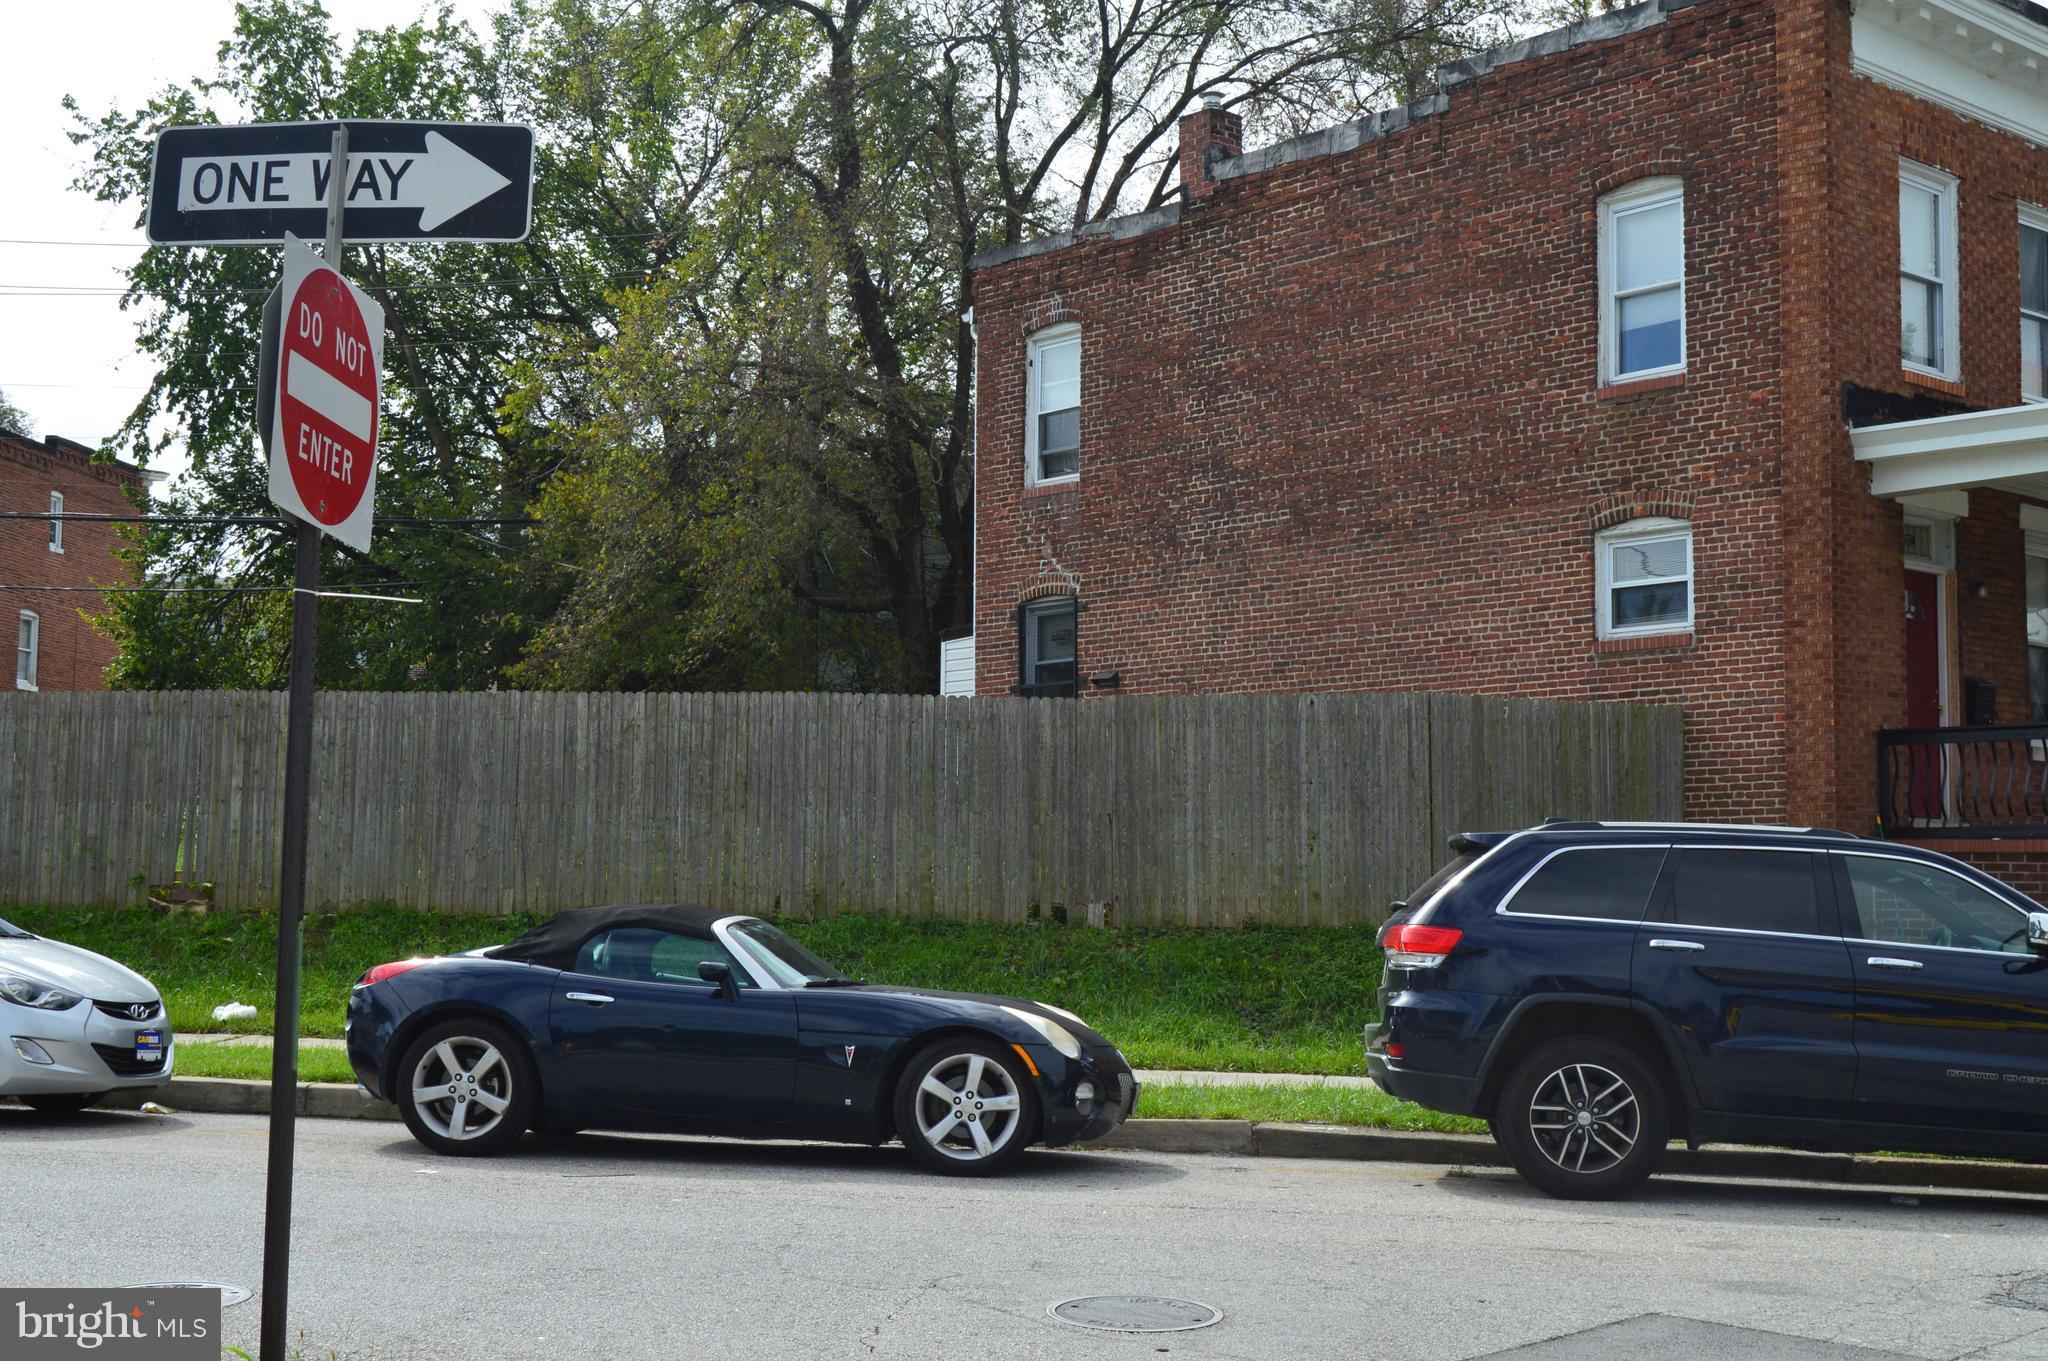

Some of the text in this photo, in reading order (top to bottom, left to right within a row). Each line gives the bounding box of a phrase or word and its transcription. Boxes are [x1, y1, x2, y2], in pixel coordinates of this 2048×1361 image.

[193, 160, 290, 205] ONE
[300, 301, 367, 377] DO NOT
[299, 422, 353, 485] ENTER
